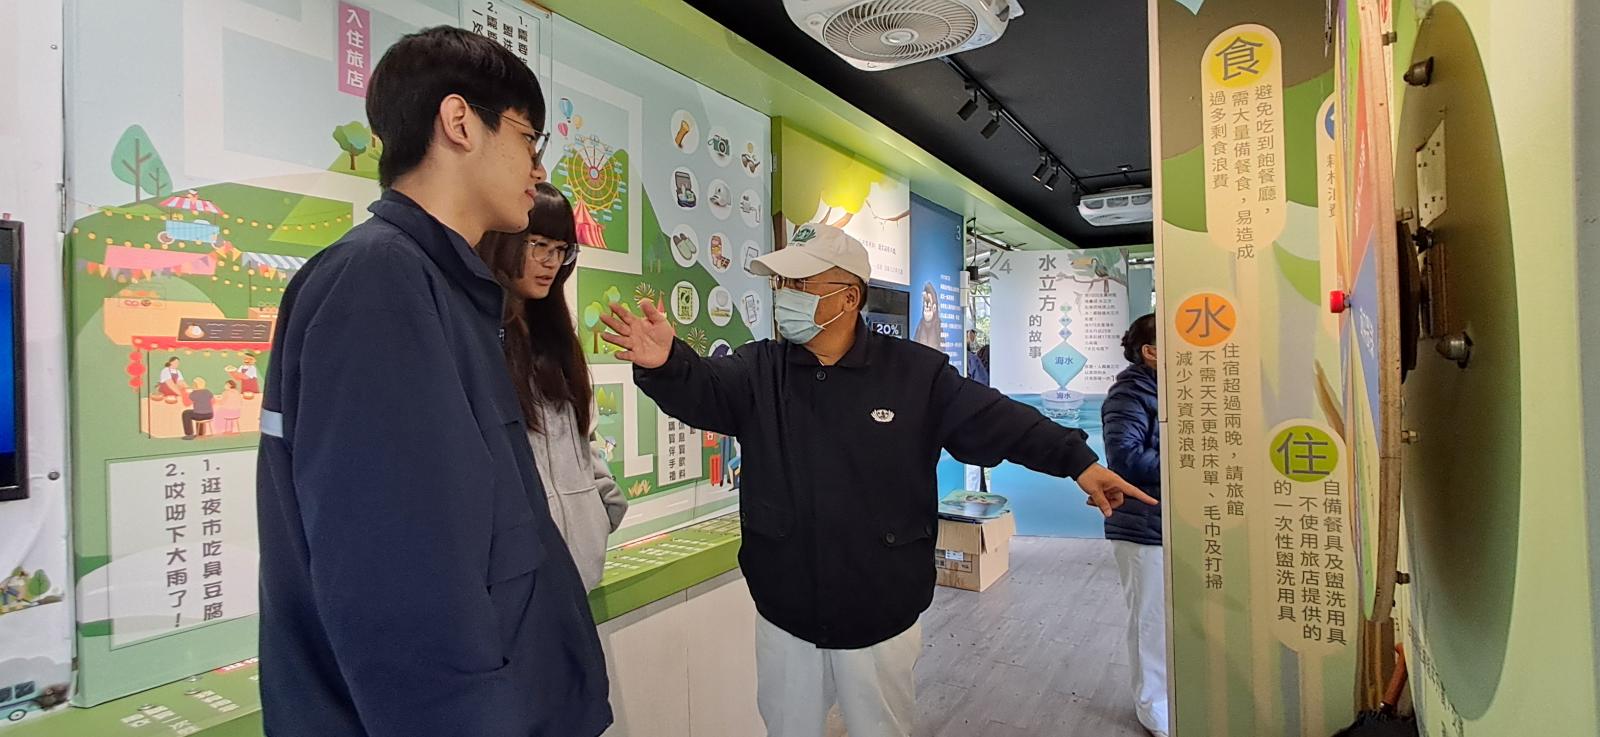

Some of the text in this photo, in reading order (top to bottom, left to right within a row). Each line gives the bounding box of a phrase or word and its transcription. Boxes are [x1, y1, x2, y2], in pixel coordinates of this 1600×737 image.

[346, 9, 364, 88] 入住旅店
[1215, 36, 1264, 81] 食
[1210, 90, 1228, 190] 過多剩食浪費
[1232, 91, 1255, 260] 需大量備餐食，易造成
[1255, 84, 1277, 214] 避免吃到飽餐廳，
[876, 323, 899, 335] 20%
[1028, 314, 1042, 359] 的故事
[1038, 254, 1057, 312] 水立方
[1185, 296, 1232, 338] 水
[1176, 351, 1195, 470] 減少水資源浪費
[1199, 350, 1223, 590] 不需天天更換床單、毛巾及打掃
[1222, 343, 1245, 516] 住宿超過兩晚，請旅館
[1276, 432, 1331, 476] 住
[201, 459, 223, 621] 1.逛夜市吃臭豆腐
[1273, 480, 1297, 623] 的一次性盥洗用具
[1298, 496, 1322, 641] 不使用旅店提供的
[1323, 480, 1348, 646] 自備餐具及盥洗用具
